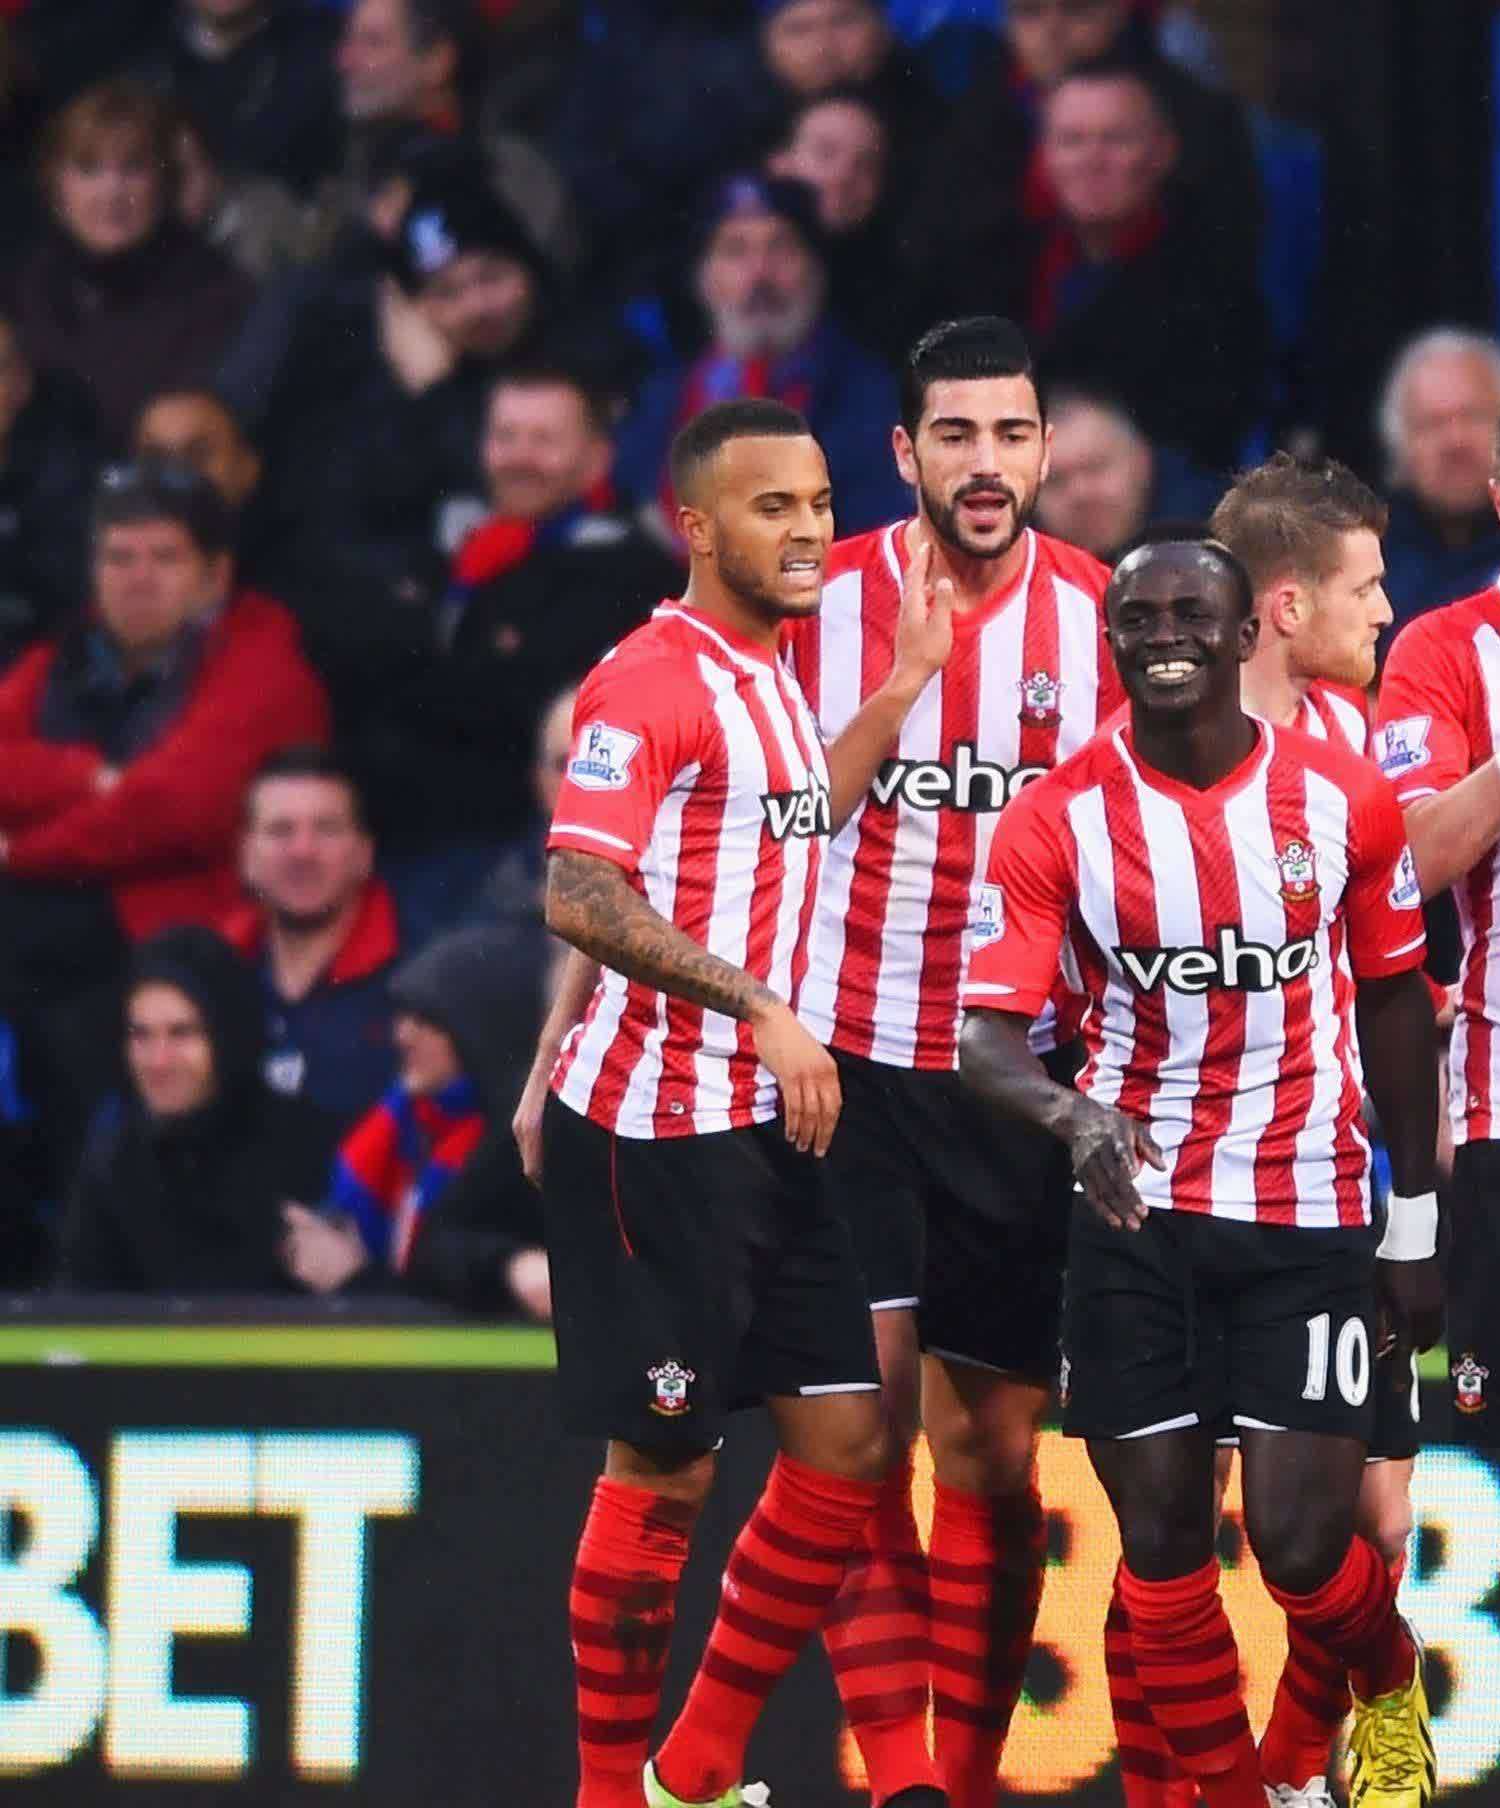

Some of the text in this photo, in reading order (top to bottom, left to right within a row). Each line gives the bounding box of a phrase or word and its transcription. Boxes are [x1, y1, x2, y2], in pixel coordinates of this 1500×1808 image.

[765, 770, 831, 839] veh
[1121, 928, 1313, 991] veho
[1301, 1312, 1370, 1407] 10
